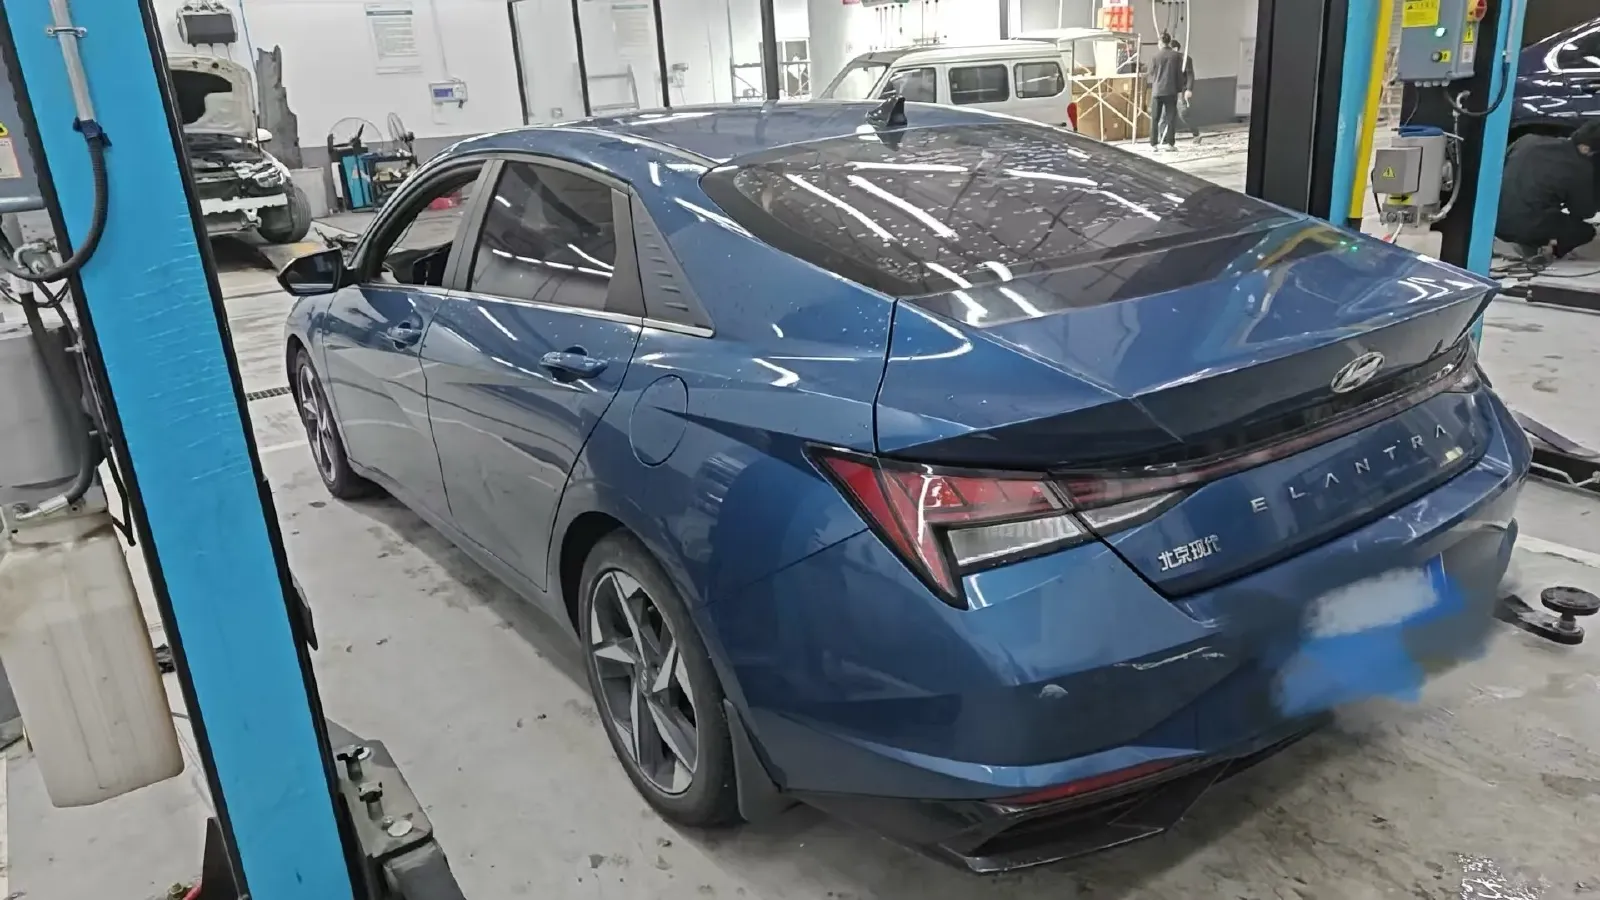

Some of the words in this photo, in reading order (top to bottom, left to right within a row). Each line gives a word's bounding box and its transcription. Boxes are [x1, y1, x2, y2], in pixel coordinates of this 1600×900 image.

[1250, 424, 1447, 513] ELANTRA
[1158, 534, 1221, 571] 北京现代
